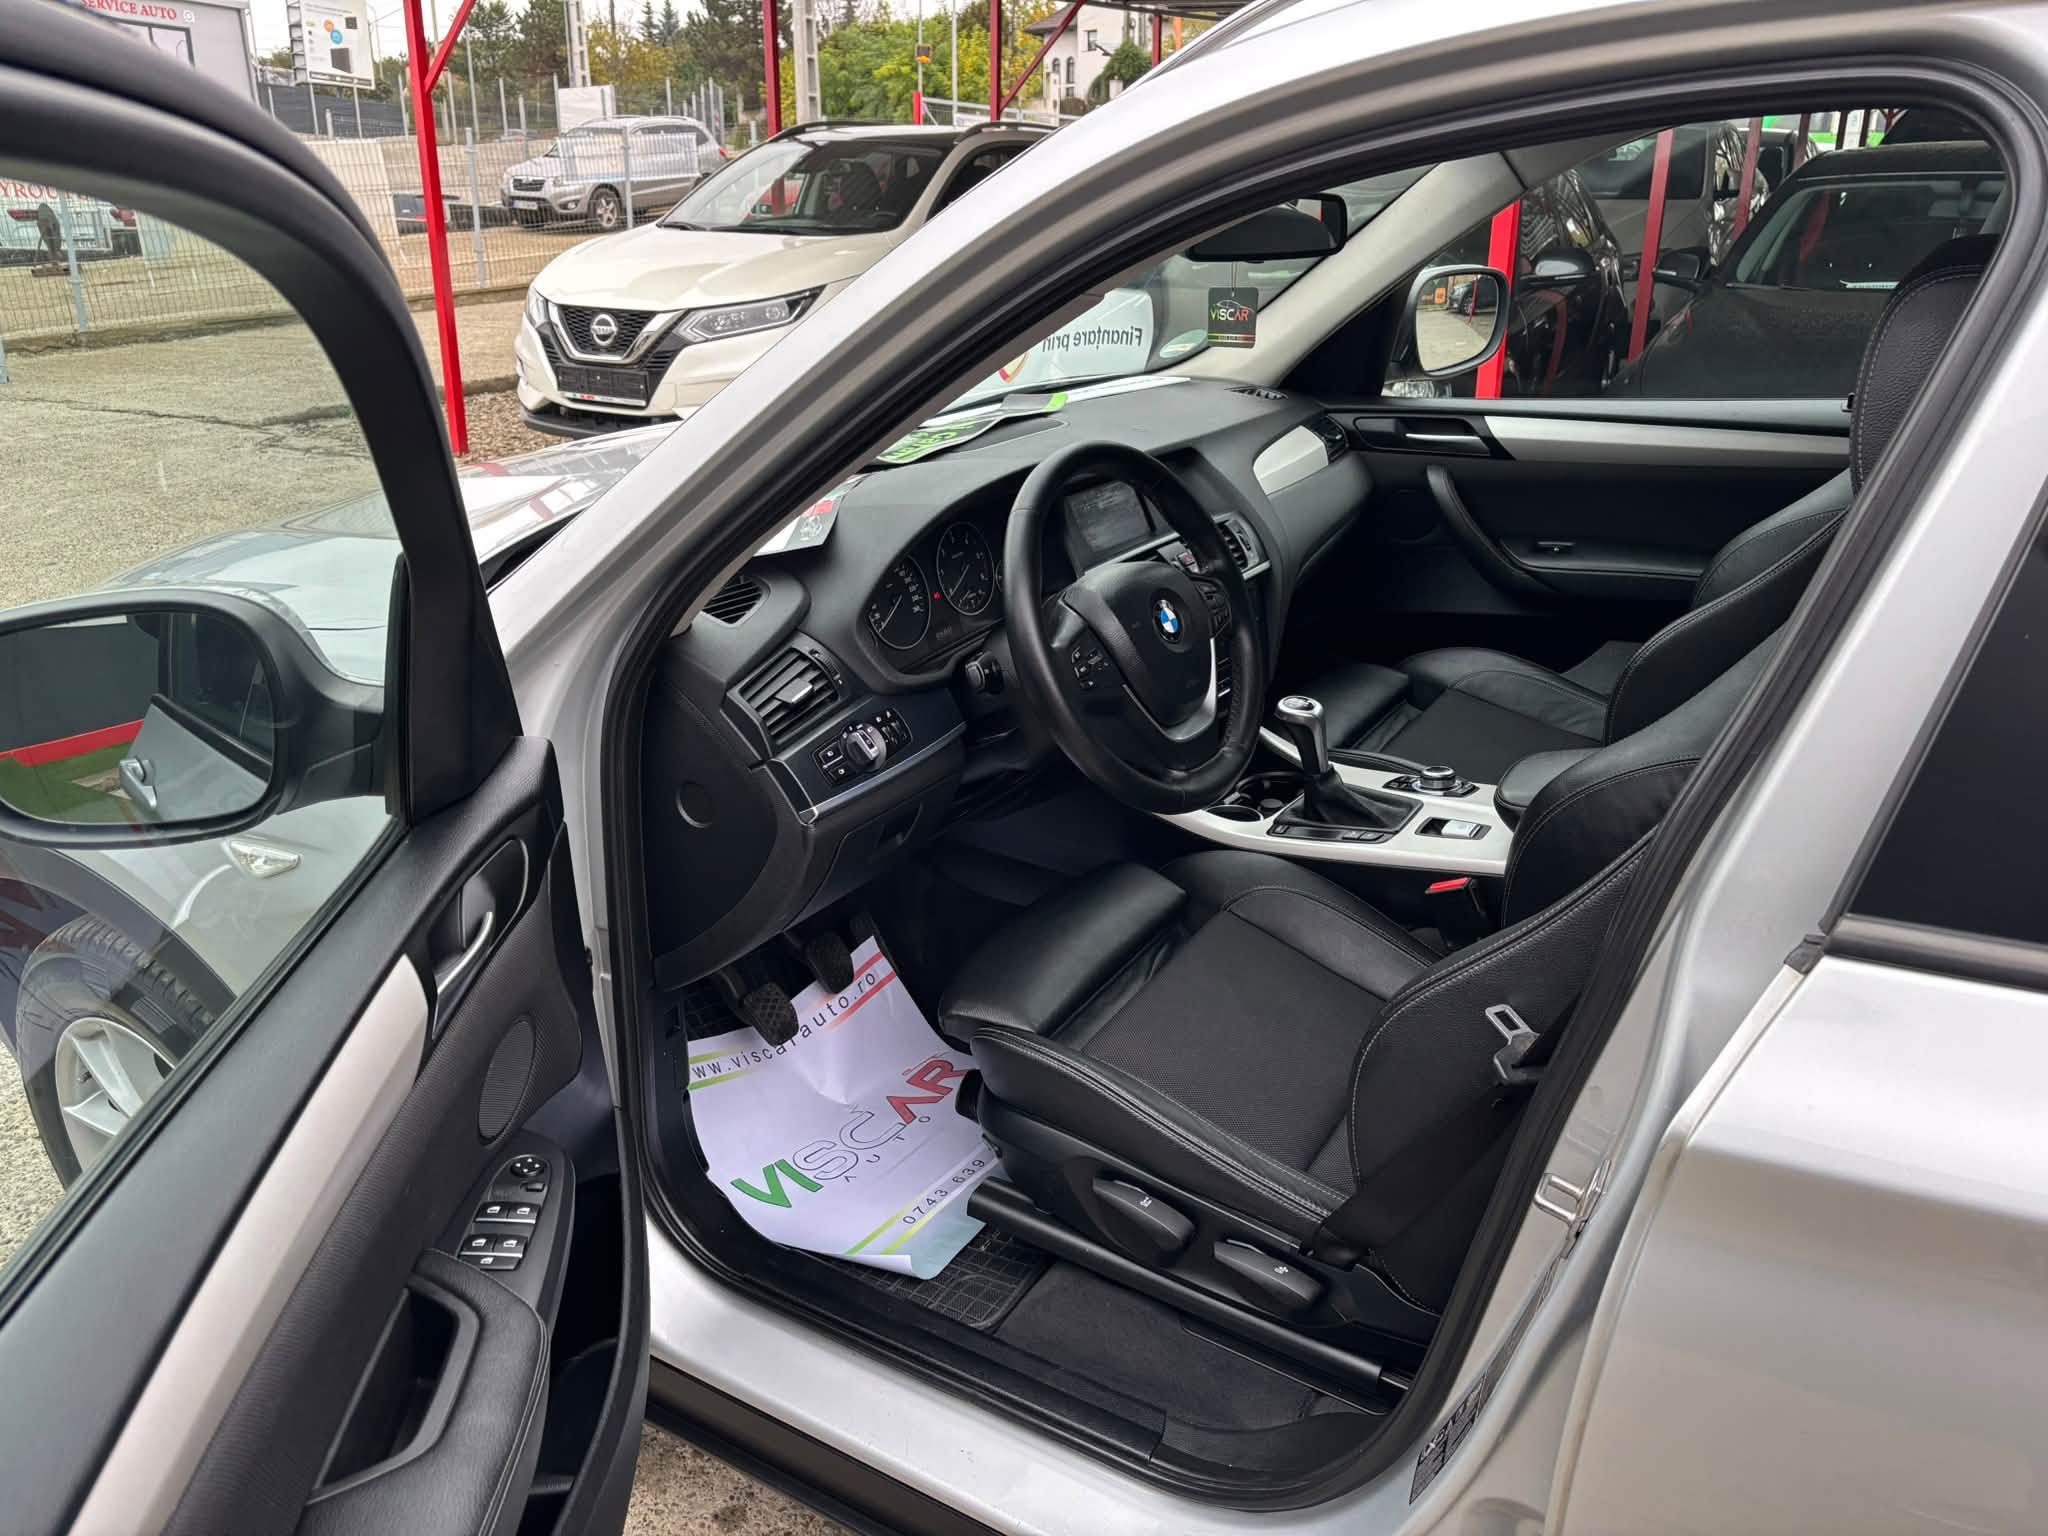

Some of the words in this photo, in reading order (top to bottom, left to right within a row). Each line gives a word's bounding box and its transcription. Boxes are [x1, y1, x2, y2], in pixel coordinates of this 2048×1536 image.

[140, 5, 177, 20] AUTO
[1210, 305, 1249, 321] VISCAR
[730, 1059, 968, 1209] VISCAR
[903, 1189, 949, 1224] 0743
[952, 1160, 985, 1183] 639
